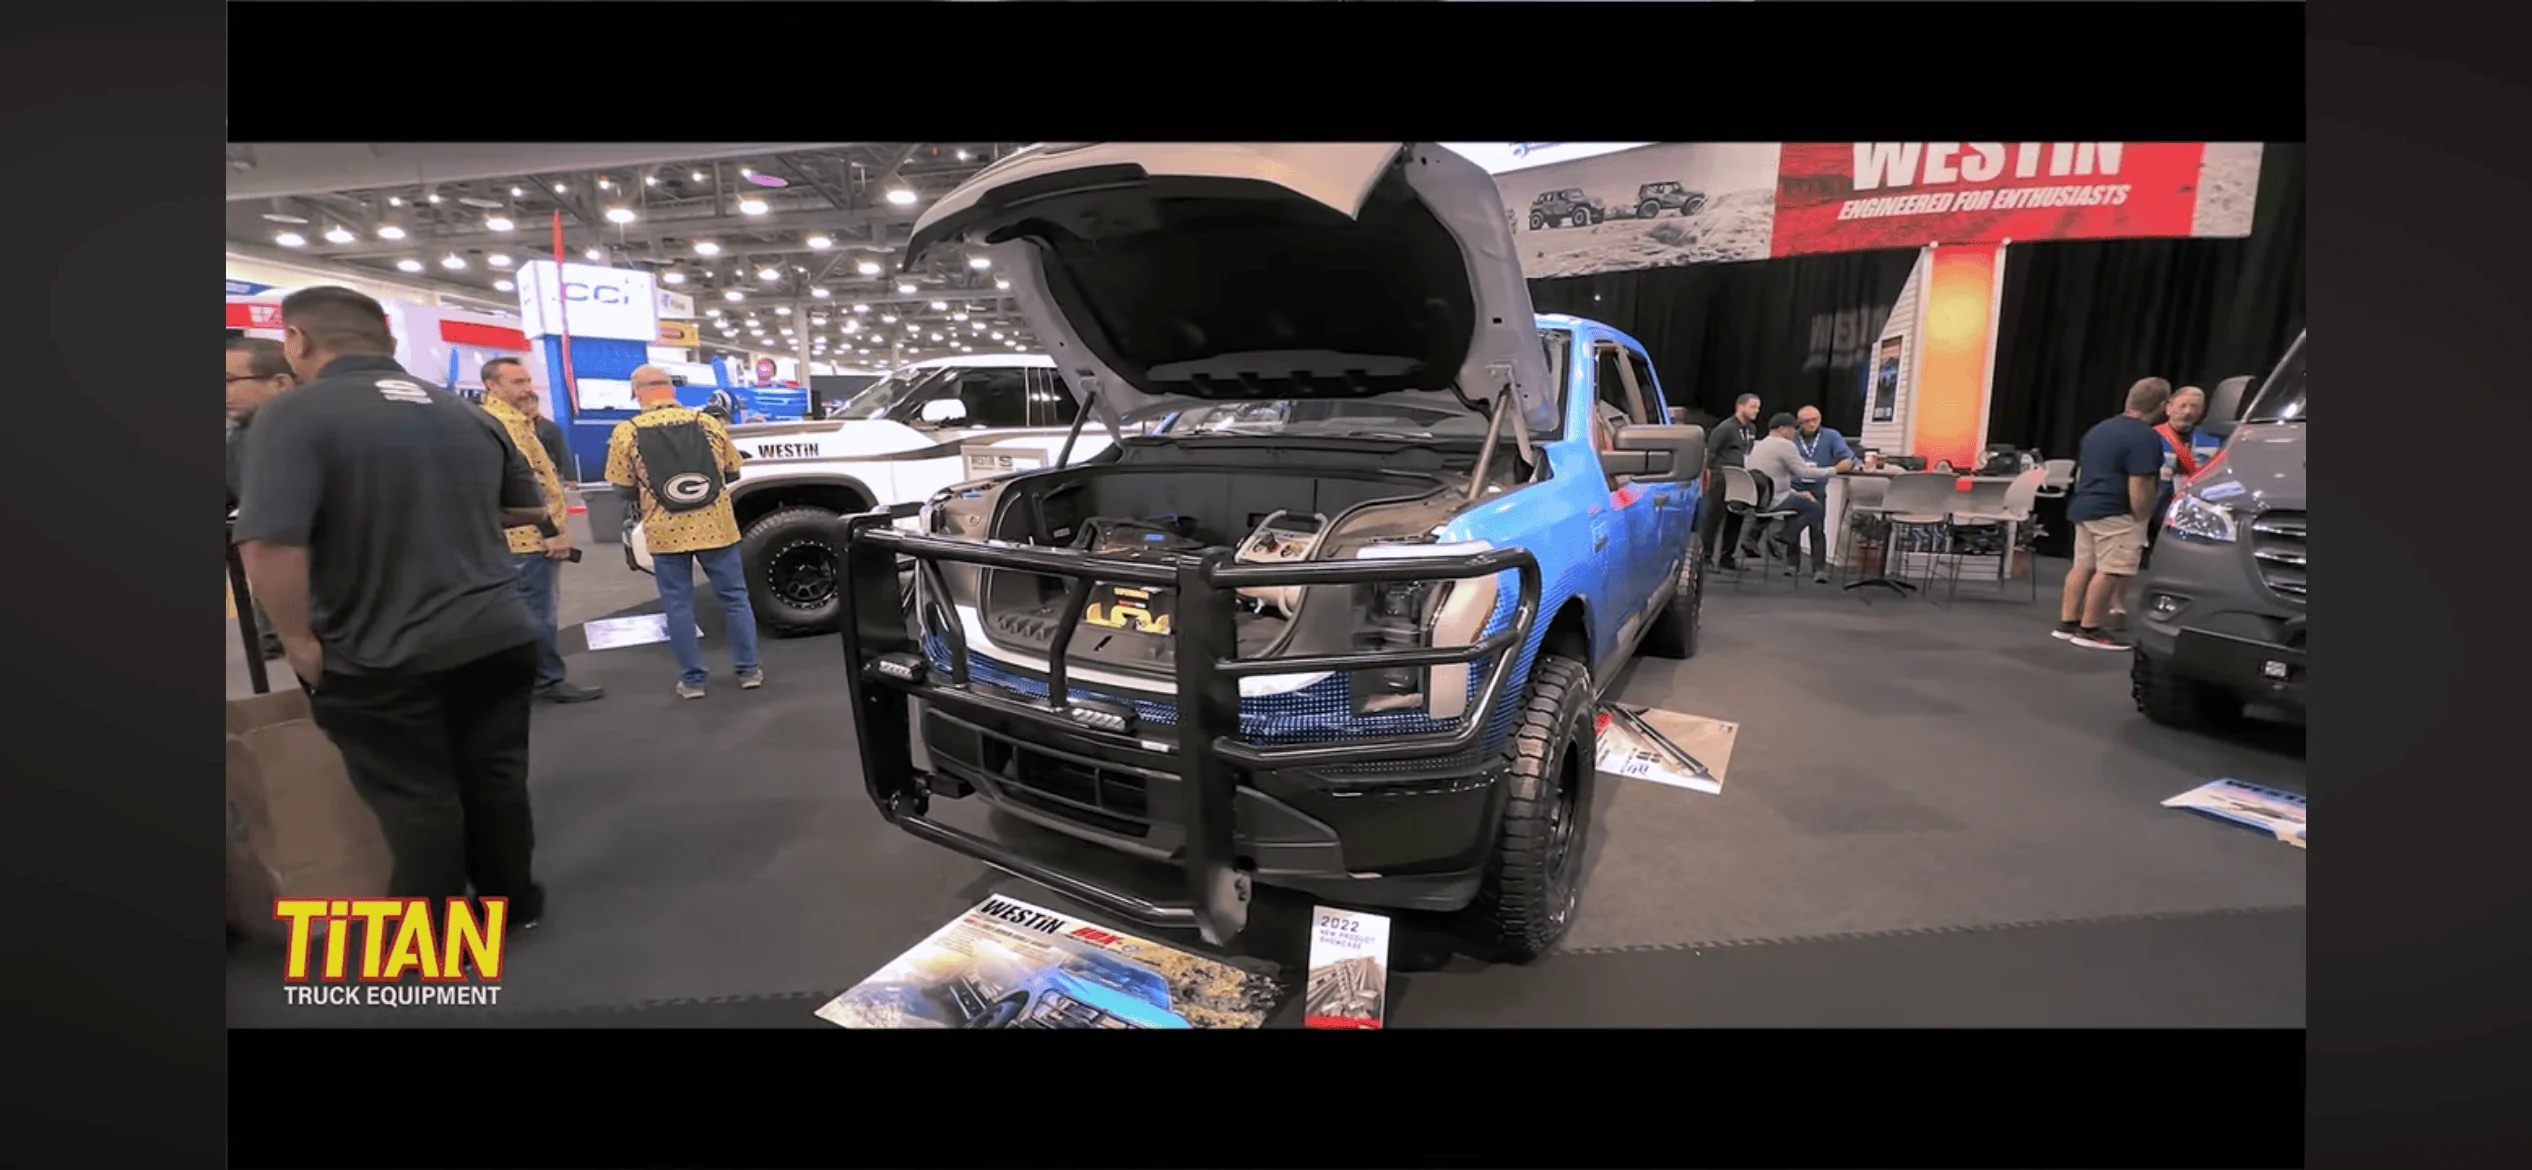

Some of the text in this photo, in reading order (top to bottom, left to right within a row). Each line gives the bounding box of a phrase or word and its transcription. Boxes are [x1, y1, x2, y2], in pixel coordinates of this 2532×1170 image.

[1838, 184, 2131, 220] ENGINEERED FOR ENTHUSIASTS
[1320, 916, 1359, 931] 2022
